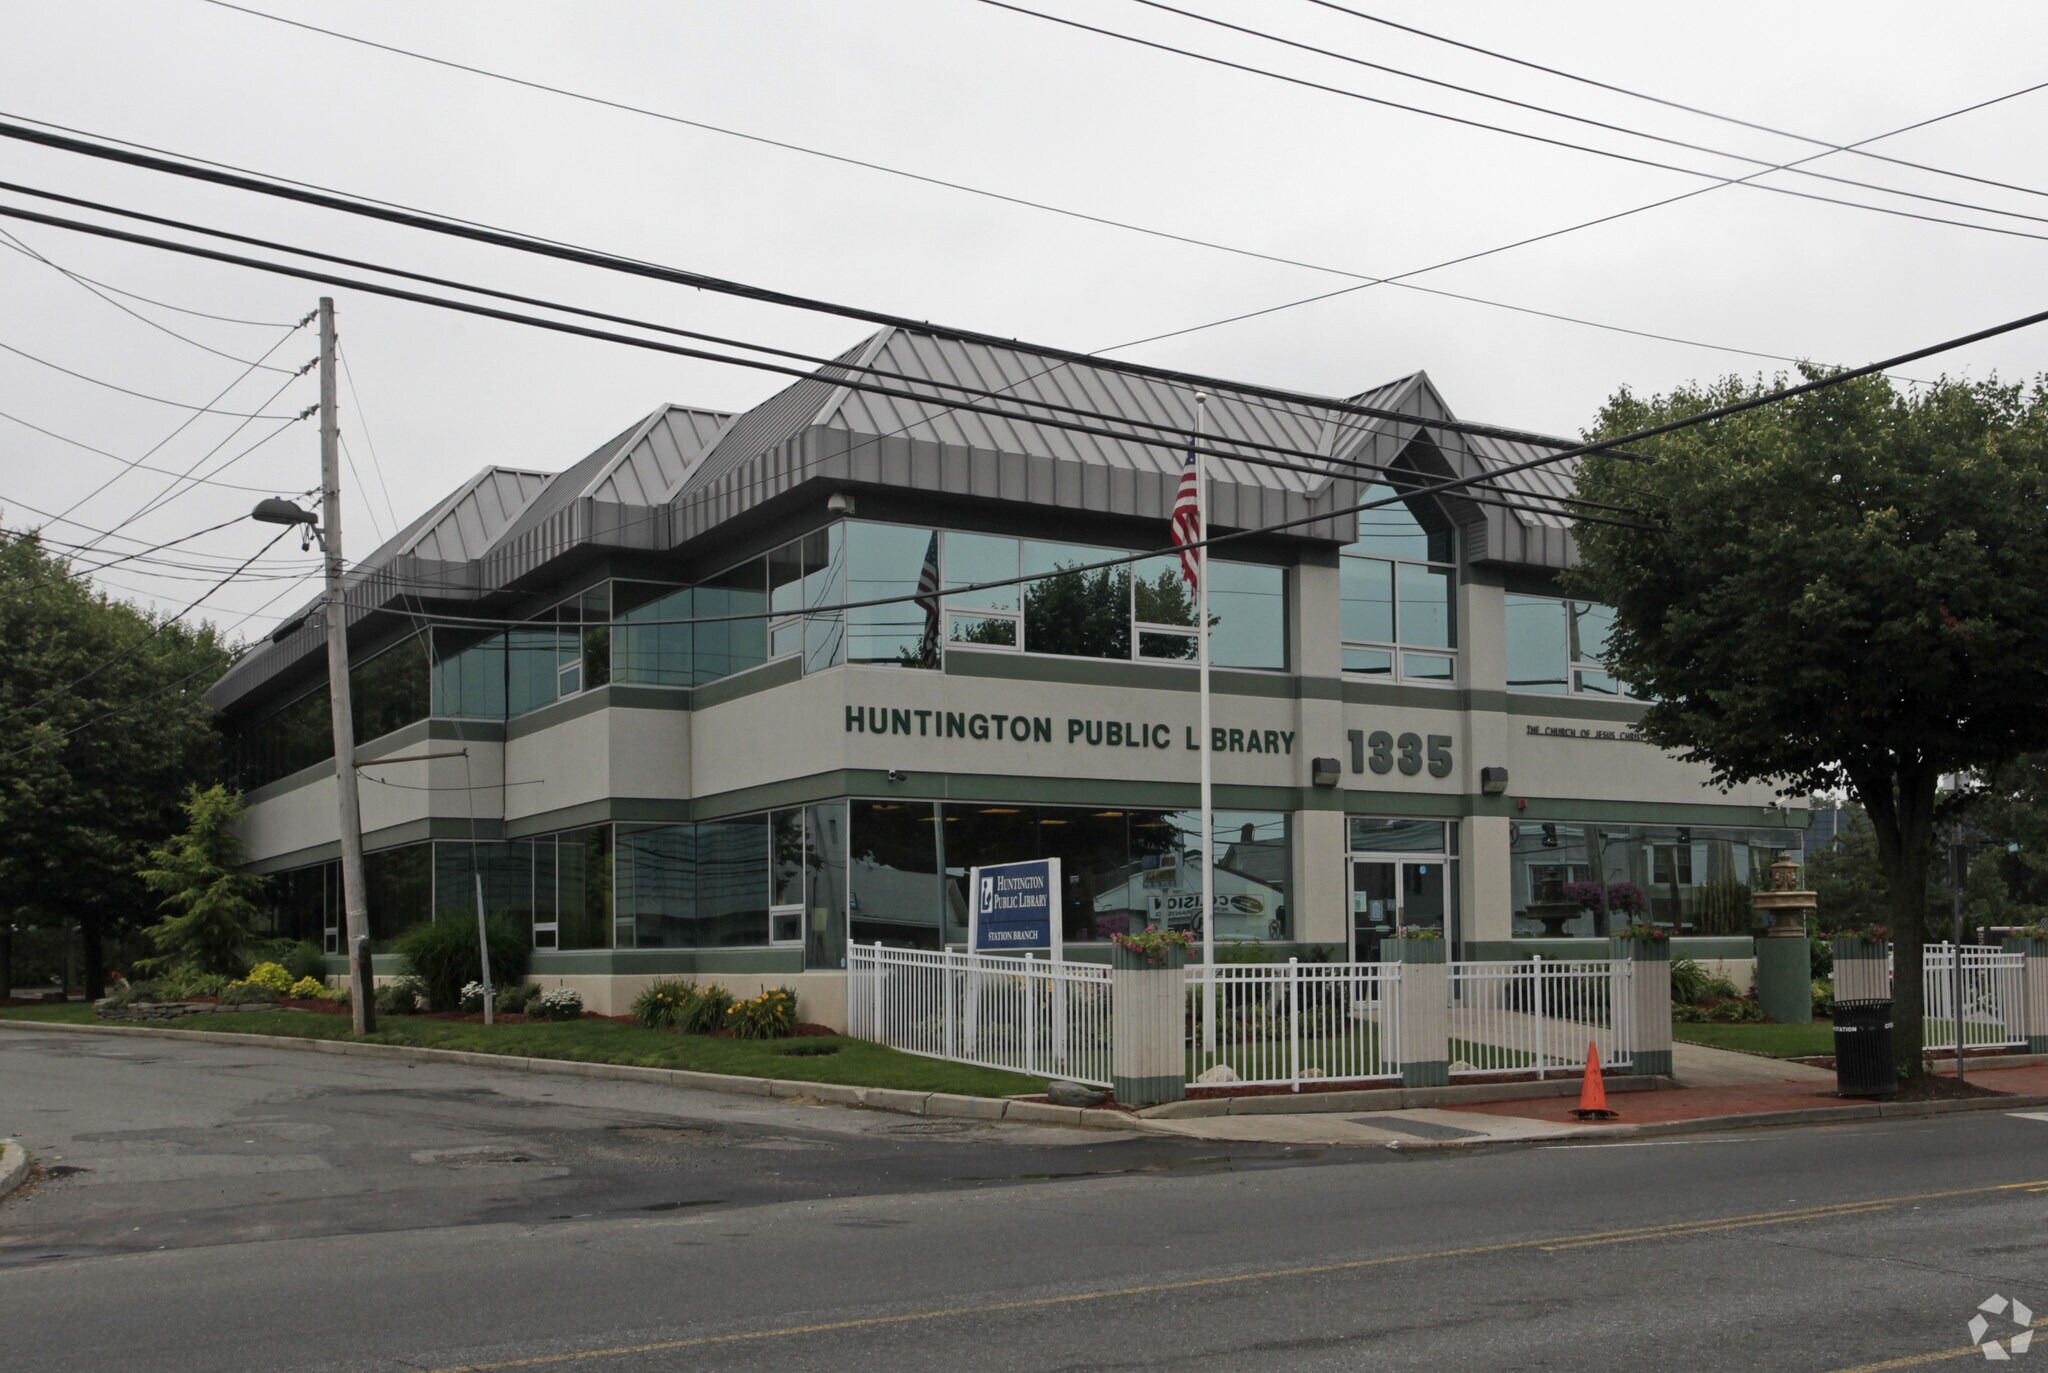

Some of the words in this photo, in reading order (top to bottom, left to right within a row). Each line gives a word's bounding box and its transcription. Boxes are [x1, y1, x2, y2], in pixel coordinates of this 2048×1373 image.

[844, 705, 1052, 743] HUNTINGTON
[1067, 718, 1171, 750] PUBLIC
[1185, 725, 1296, 755] LBRARY
[1526, 724, 1540, 735] THE
[1544, 726, 1576, 738] CHURCH
[1579, 729, 1591, 738] OF
[1595, 730, 1616, 740] JESUS
[1348, 729, 1453, 778] 1335
[997, 876, 1044, 891] HUNTINGTON
[994, 894, 1018, 910] PUBLIC
[1019, 892, 1047, 908] LIBRARY
[988, 931, 1013, 941] STATION
[1013, 930, 1038, 941] BRANCH
